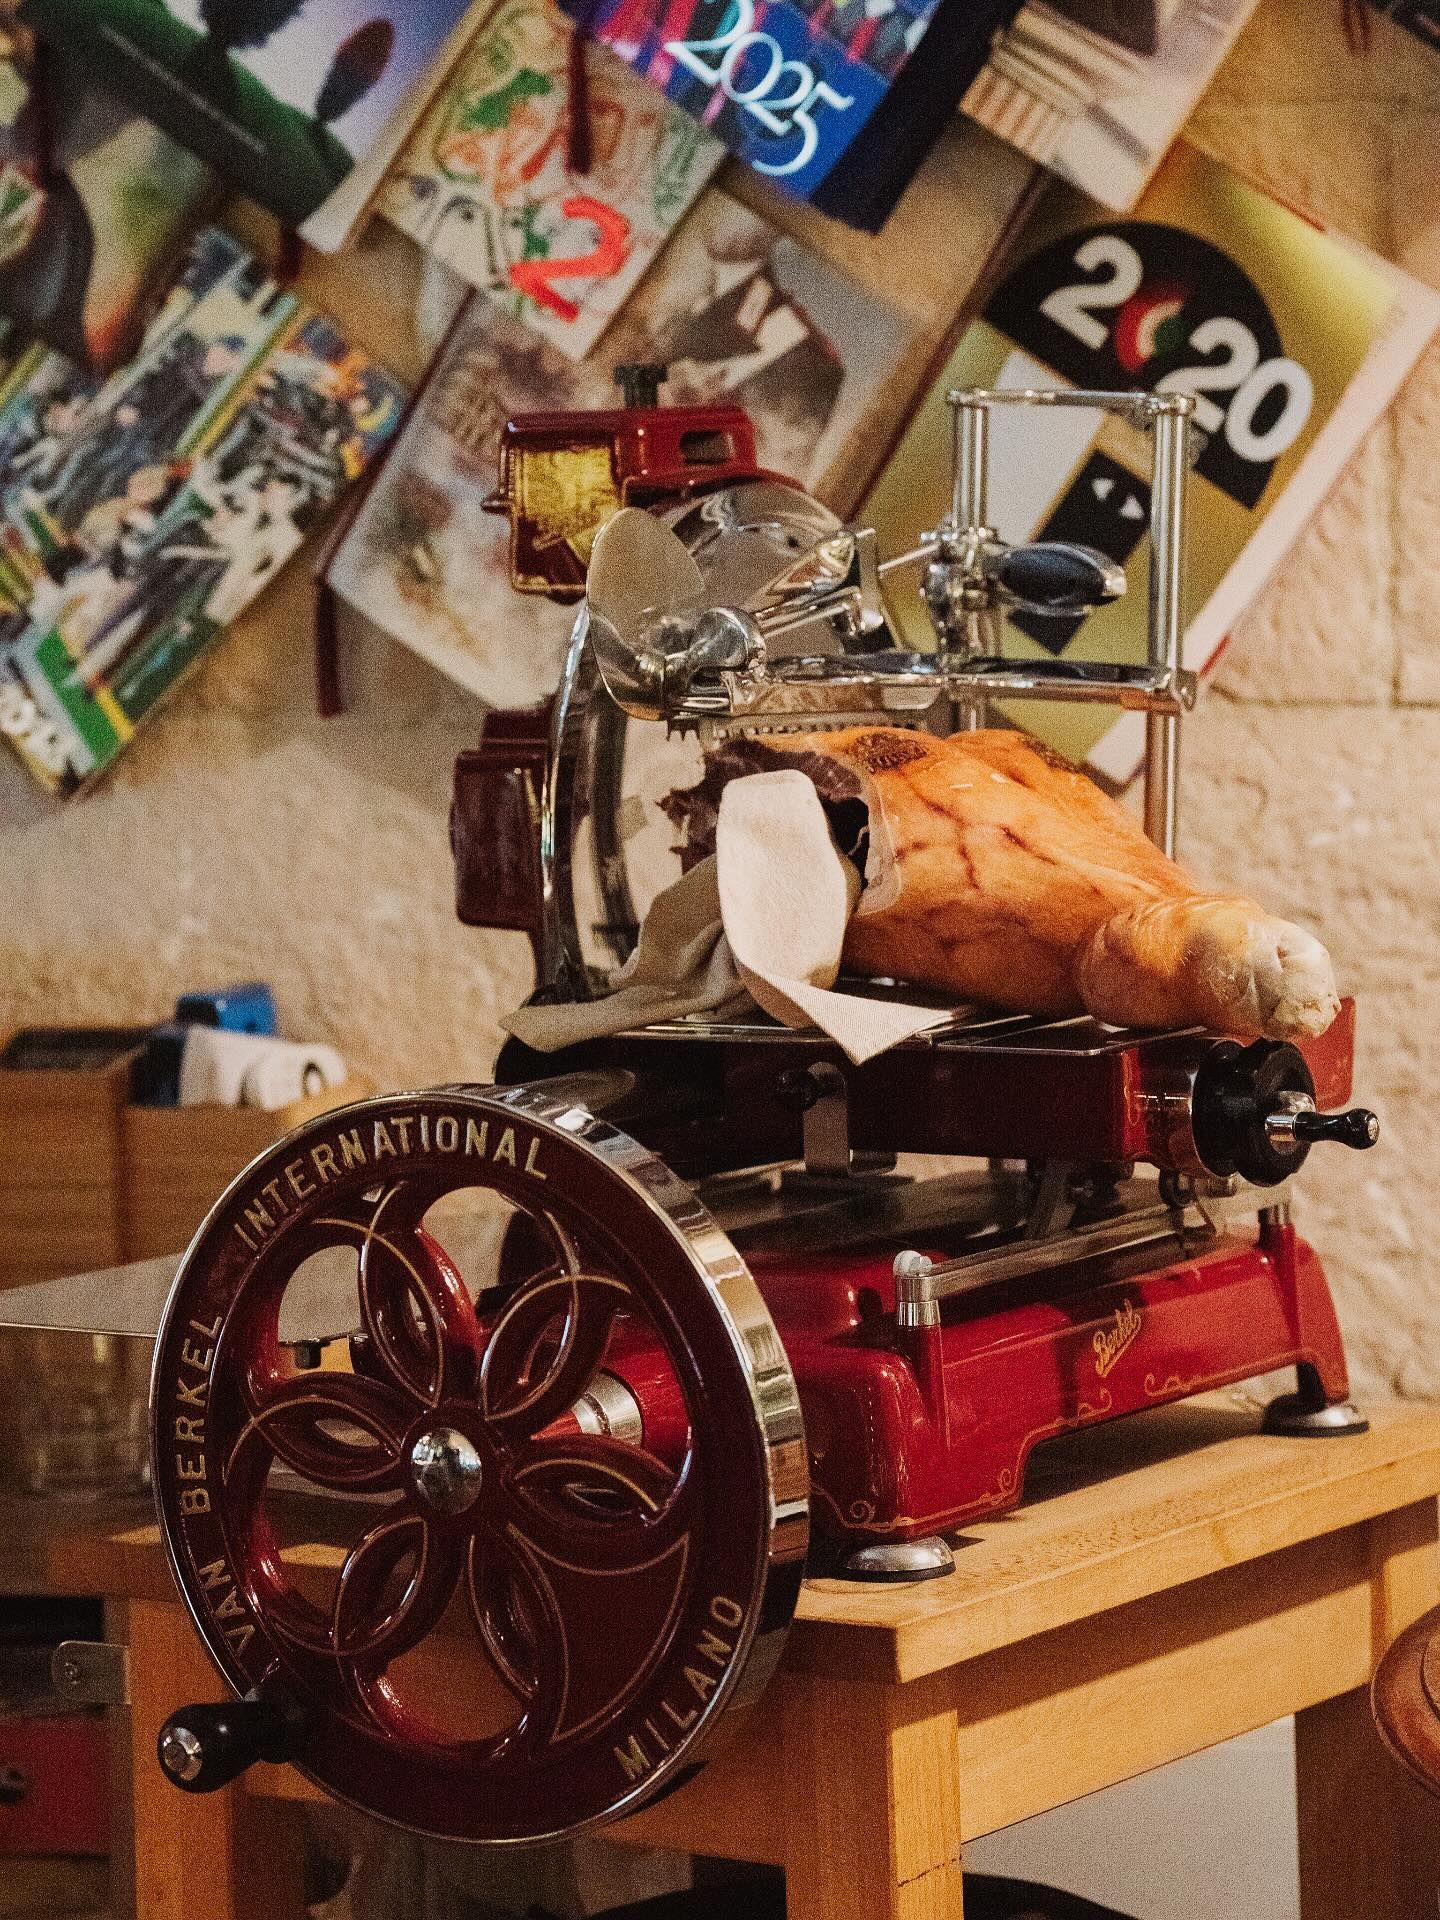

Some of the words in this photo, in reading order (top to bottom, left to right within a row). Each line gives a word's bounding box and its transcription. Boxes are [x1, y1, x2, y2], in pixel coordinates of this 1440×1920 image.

[663, 0, 855, 176] 2025
[233, 1114, 547, 1251] INTERNATIONAL
[175, 1316, 223, 1517] BERKEL
[200, 1559, 256, 1657] VAN
[613, 1596, 743, 1781] MILANO
